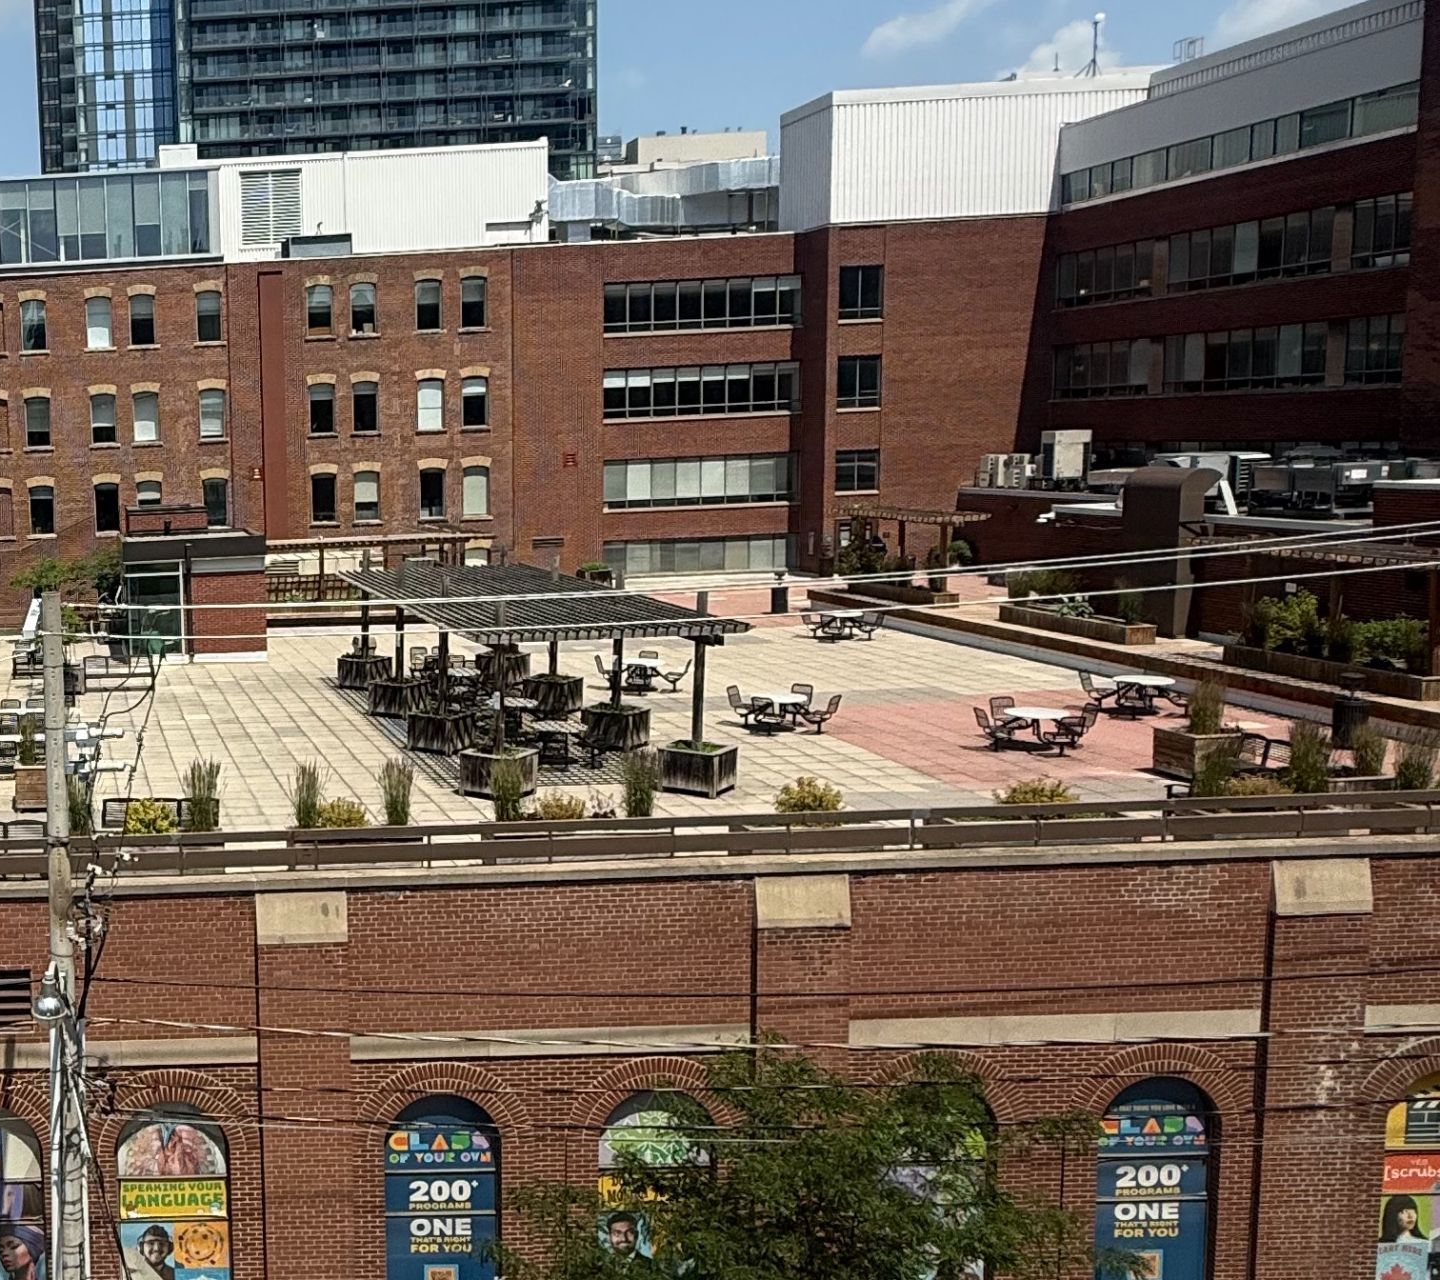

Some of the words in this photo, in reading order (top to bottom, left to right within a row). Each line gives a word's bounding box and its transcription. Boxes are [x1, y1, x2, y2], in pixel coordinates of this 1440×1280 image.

[389, 1152, 410, 1163] OF
[415, 1152, 456, 1163] YOUR
[460, 1152, 492, 1163] OWN
[122, 1183, 185, 1193] SPEAKING
[188, 1182, 222, 1191] YOUR
[1115, 1187, 1181, 1196] PROGRAMS
[122, 1192, 224, 1209] LANGUAGE
[409, 1202, 471, 1210] PROGRAMS
[1114, 1203, 1180, 1220] ONE
[410, 1218, 472, 1236] ONE
[1114, 1228, 1144, 1238] FOR
[1147, 1228, 1179, 1237] YOU
[410, 1243, 439, 1253] FOR
[442, 1243, 472, 1253] YOU
